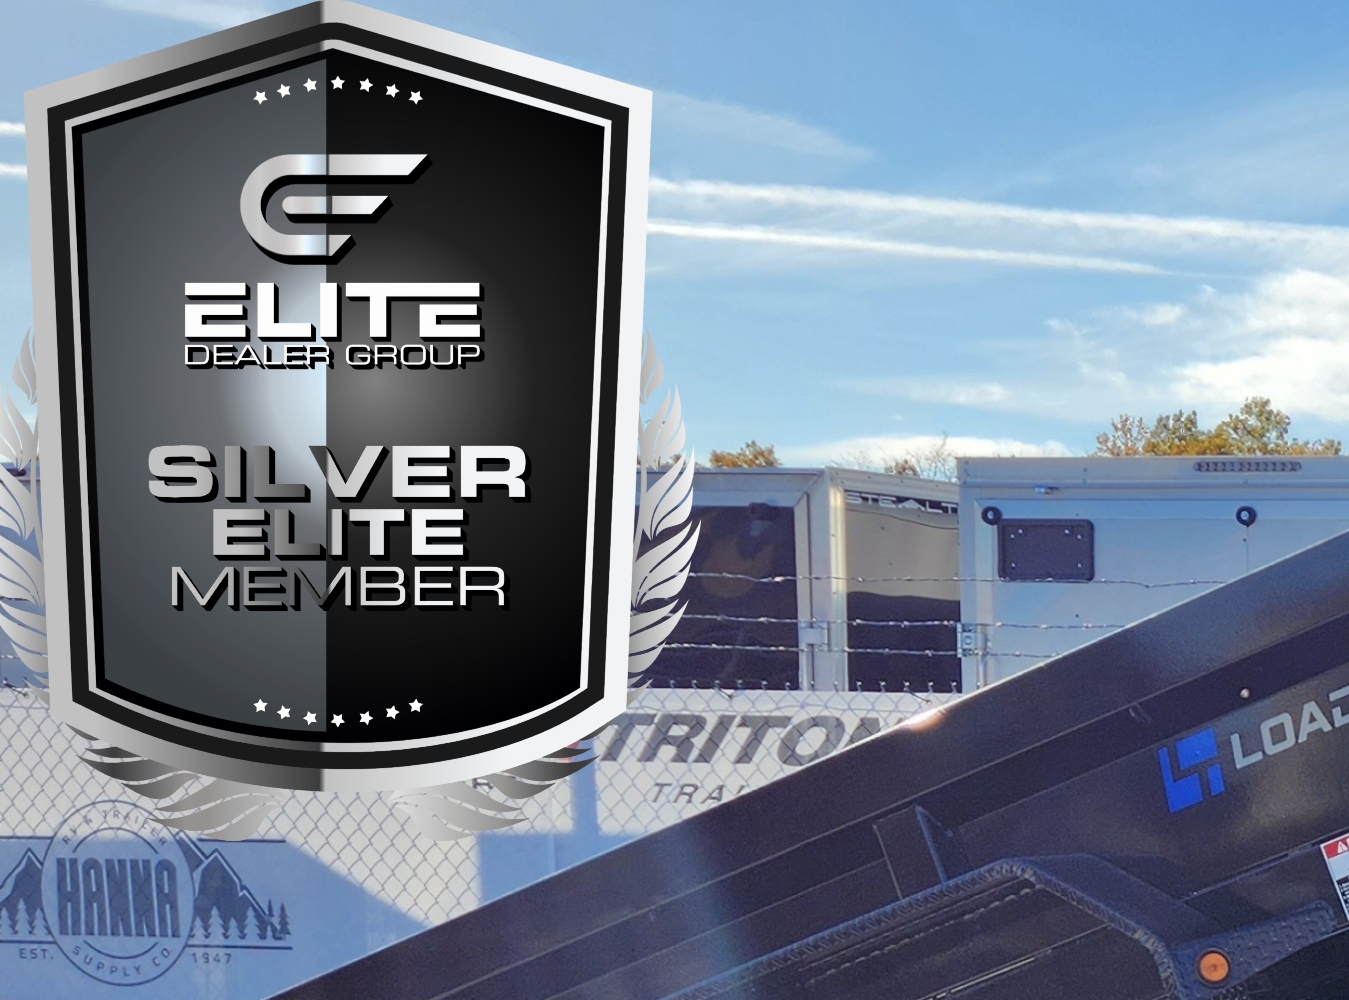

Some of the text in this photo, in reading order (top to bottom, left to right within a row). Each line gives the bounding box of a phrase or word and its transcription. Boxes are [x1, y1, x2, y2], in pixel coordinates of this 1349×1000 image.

[845, 492, 959, 514] STEALT
[62, 826, 79, 846] RV
[103, 809, 168, 848] TRAILER
[56, 857, 181, 938] HANNA
[19, 947, 55, 961] EST.
[71, 945, 143, 978] SUPPLY
[191, 952, 233, 965] 1947
